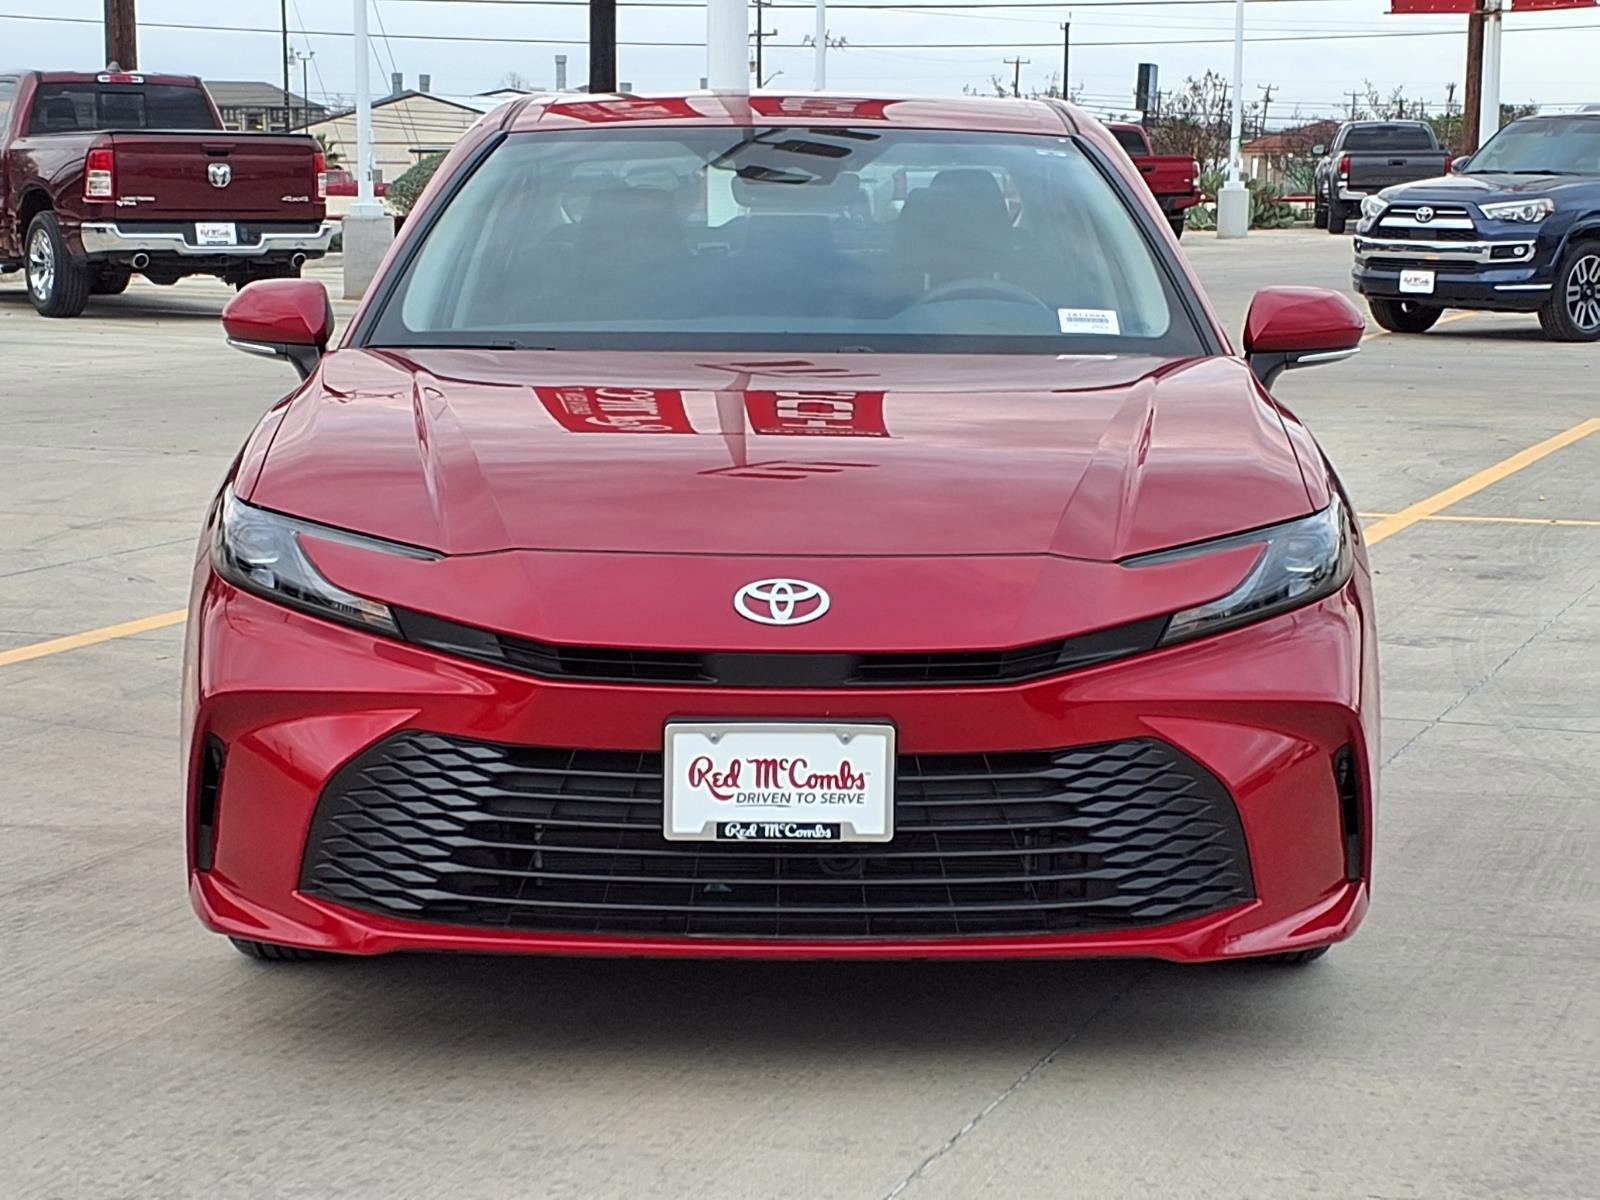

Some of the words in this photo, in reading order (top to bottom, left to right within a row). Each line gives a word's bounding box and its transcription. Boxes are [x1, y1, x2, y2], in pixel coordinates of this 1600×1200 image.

[688, 756, 741, 801] Red
[746, 758, 865, 790] McCombs
[736, 791, 791, 804] DRIVEN
[797, 792, 815, 804] TO
[820, 792, 865, 804] SERVE
[724, 823, 757, 839] Red
[759, 823, 832, 839] McCombs
